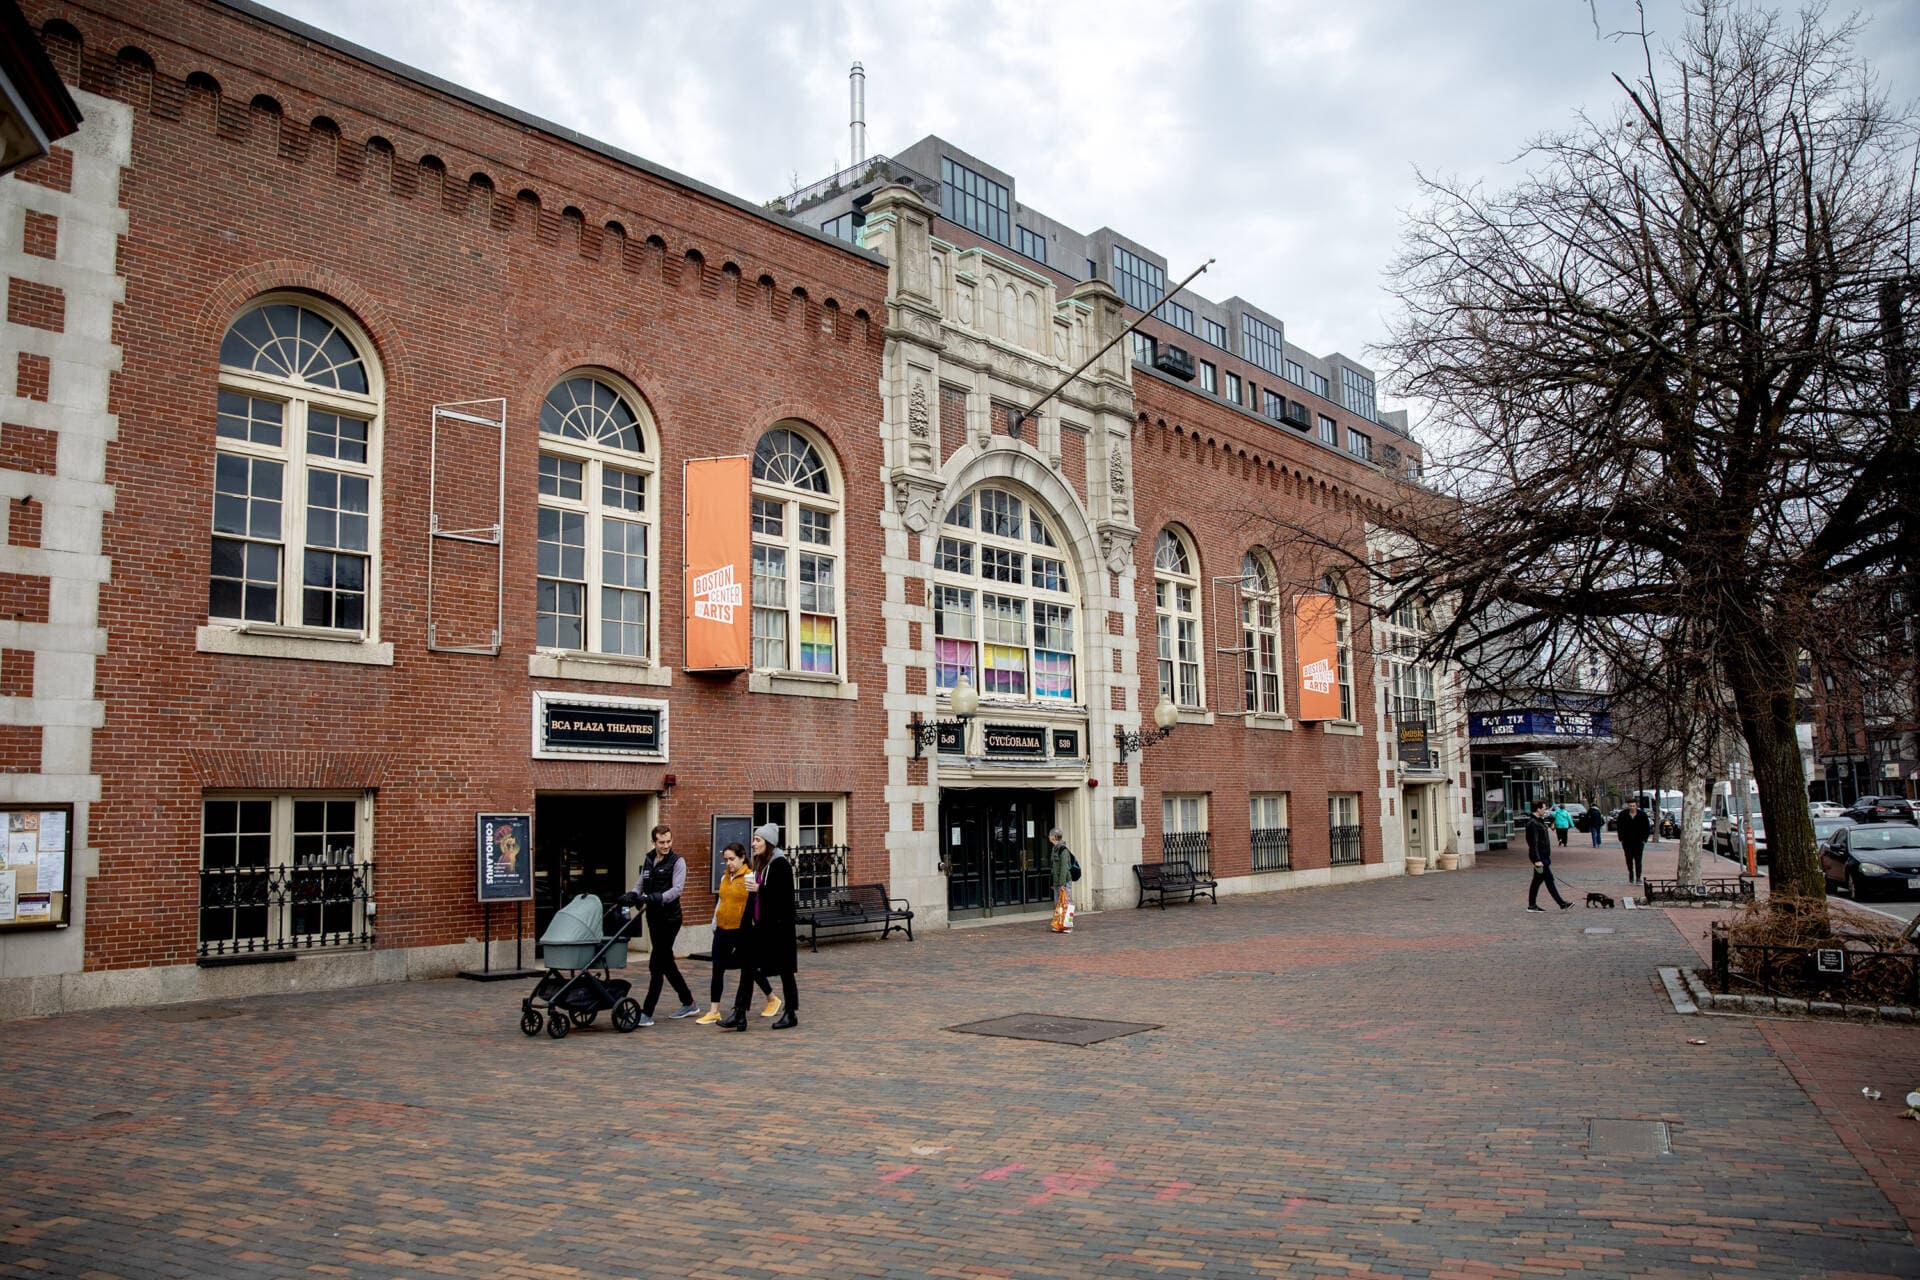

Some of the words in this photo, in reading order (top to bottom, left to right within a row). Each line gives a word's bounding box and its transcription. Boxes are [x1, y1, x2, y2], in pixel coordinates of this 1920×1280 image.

[695, 567, 731, 594] BOSTON
[710, 585, 740, 604] CENTER
[703, 603, 731, 621] ARTS
[1304, 660, 1327, 676] BOSTON
[1309, 681, 1328, 692] ARTS
[1506, 714, 1525, 724] TIX
[551, 720, 571, 730] BCA
[573, 721, 605, 732] PLAZA
[606, 723, 653, 734] THEATRES
[988, 735, 1040, 748] CYCLORAMA
[1058, 738, 1071, 748] 539
[485, 822, 494, 885] CORIOLANUS
